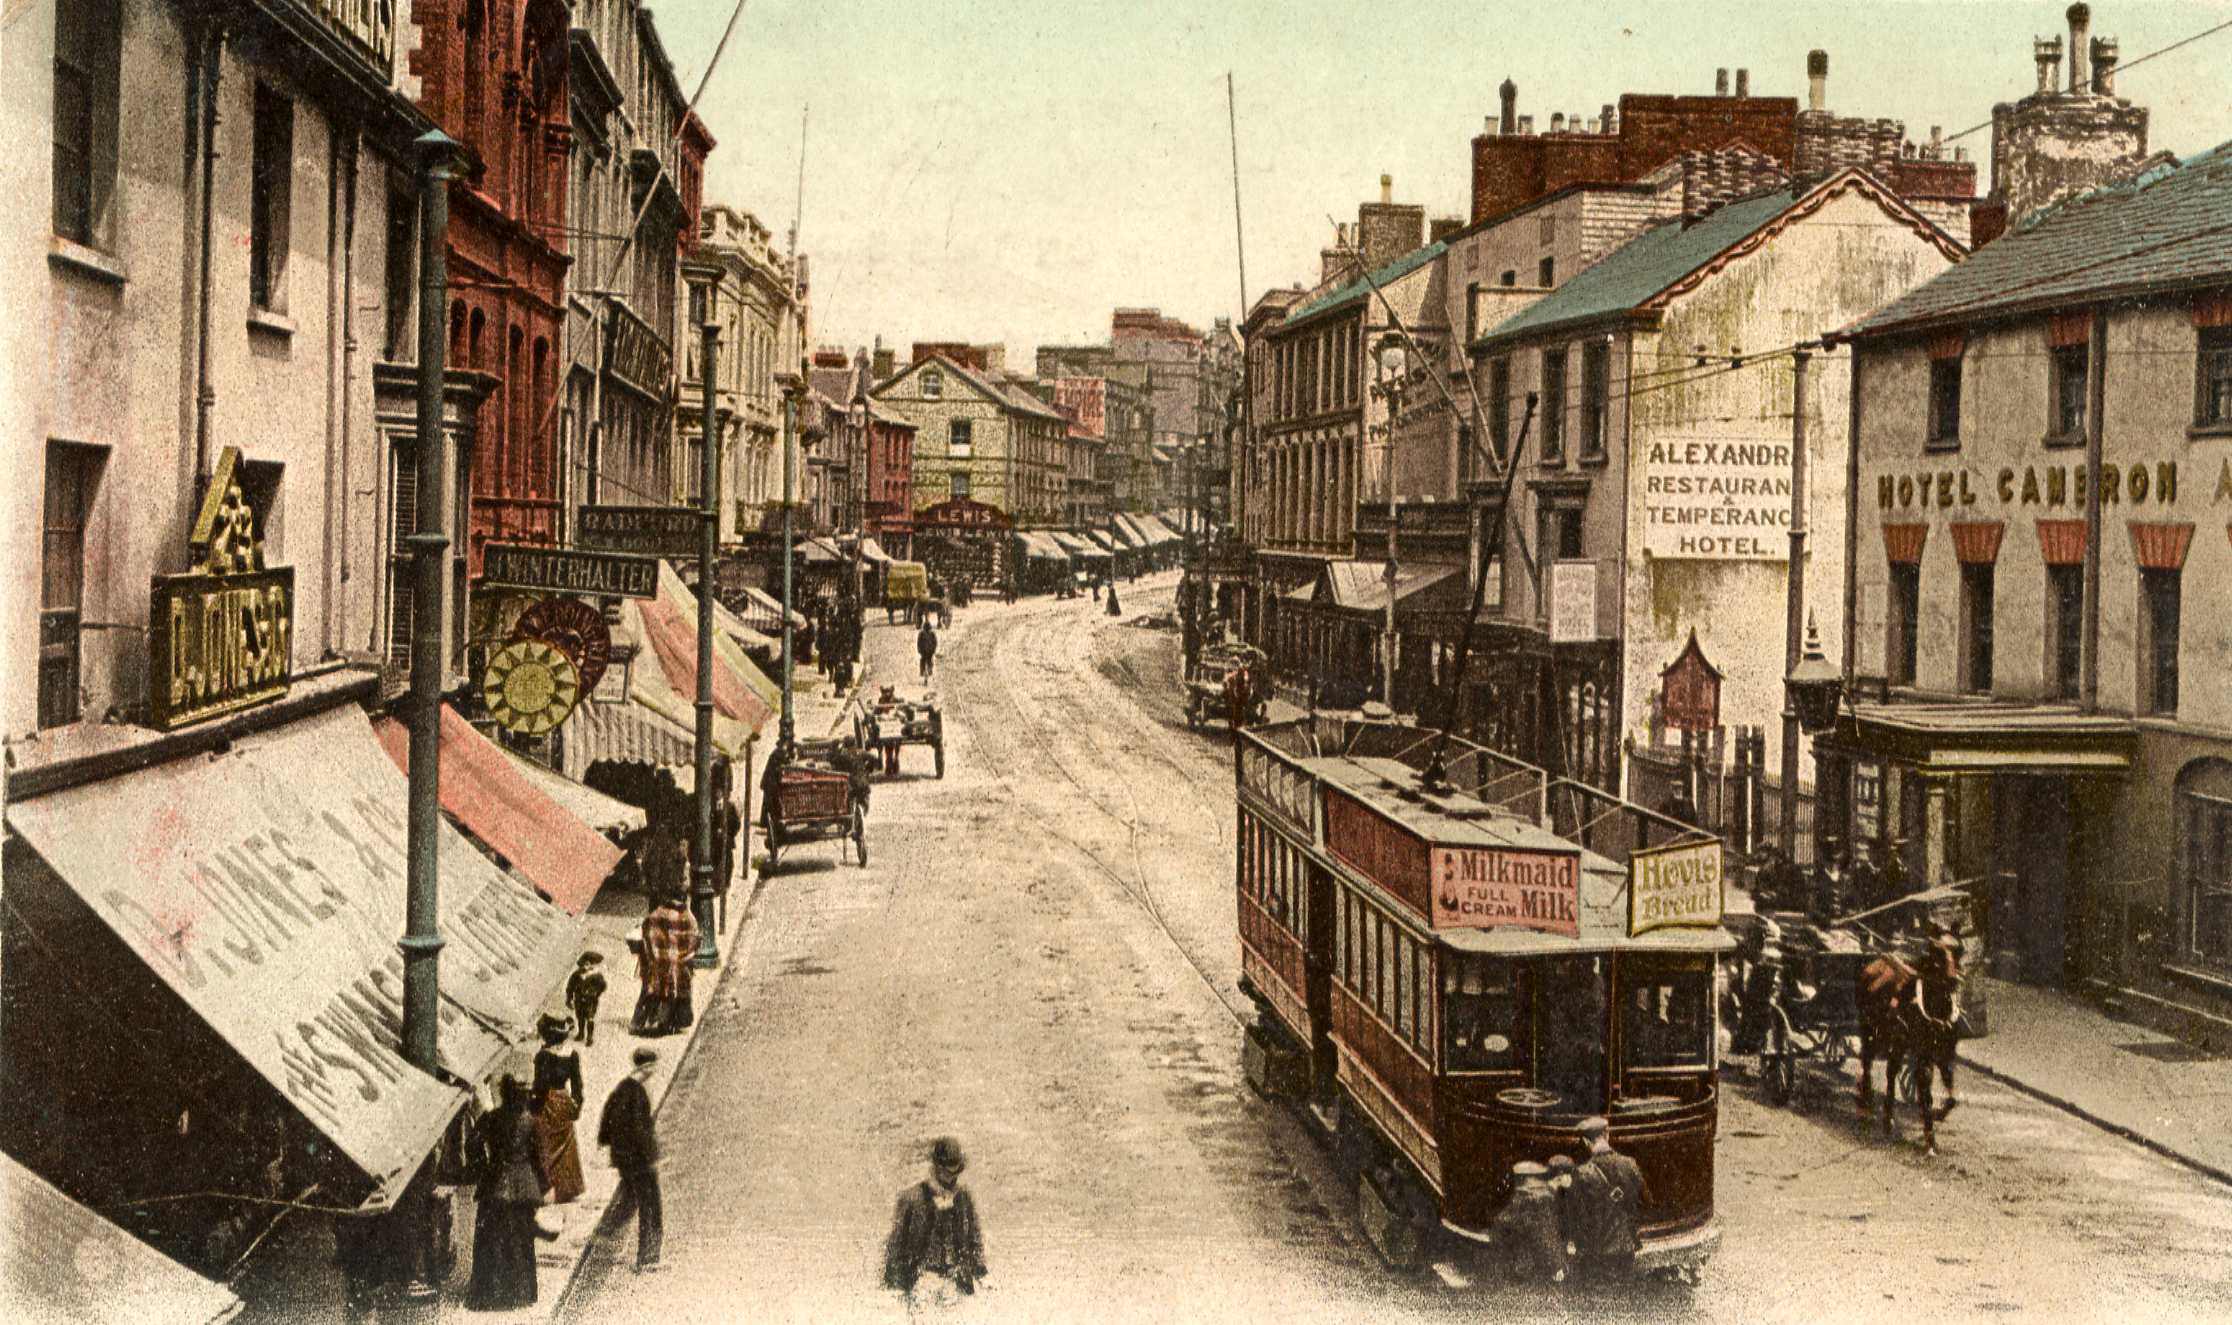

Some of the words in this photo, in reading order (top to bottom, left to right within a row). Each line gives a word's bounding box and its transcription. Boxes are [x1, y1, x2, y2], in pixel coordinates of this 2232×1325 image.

[1649, 442, 1807, 468] ALEXANDR
[1647, 475, 1793, 496] RESTAURAN
[1997, 461, 2177, 507] CAMERON
[937, 508, 992, 523] LEWIS
[1646, 506, 1808, 526] TEMPERANC
[1679, 536, 1776, 555] HOTEL.
[506, 552, 655, 592] WINTERHALTER
[1460, 850, 1574, 888] Milkmaid
[1640, 849, 1718, 891] Hovis
[180, 828, 348, 965] JONES
[1461, 902, 1517, 917] CREAM
[1467, 886, 1510, 901] FULL
[1521, 889, 1577, 921] Milk
[1641, 886, 1712, 920] Bread
[274, 1029, 341, 1127] THE
